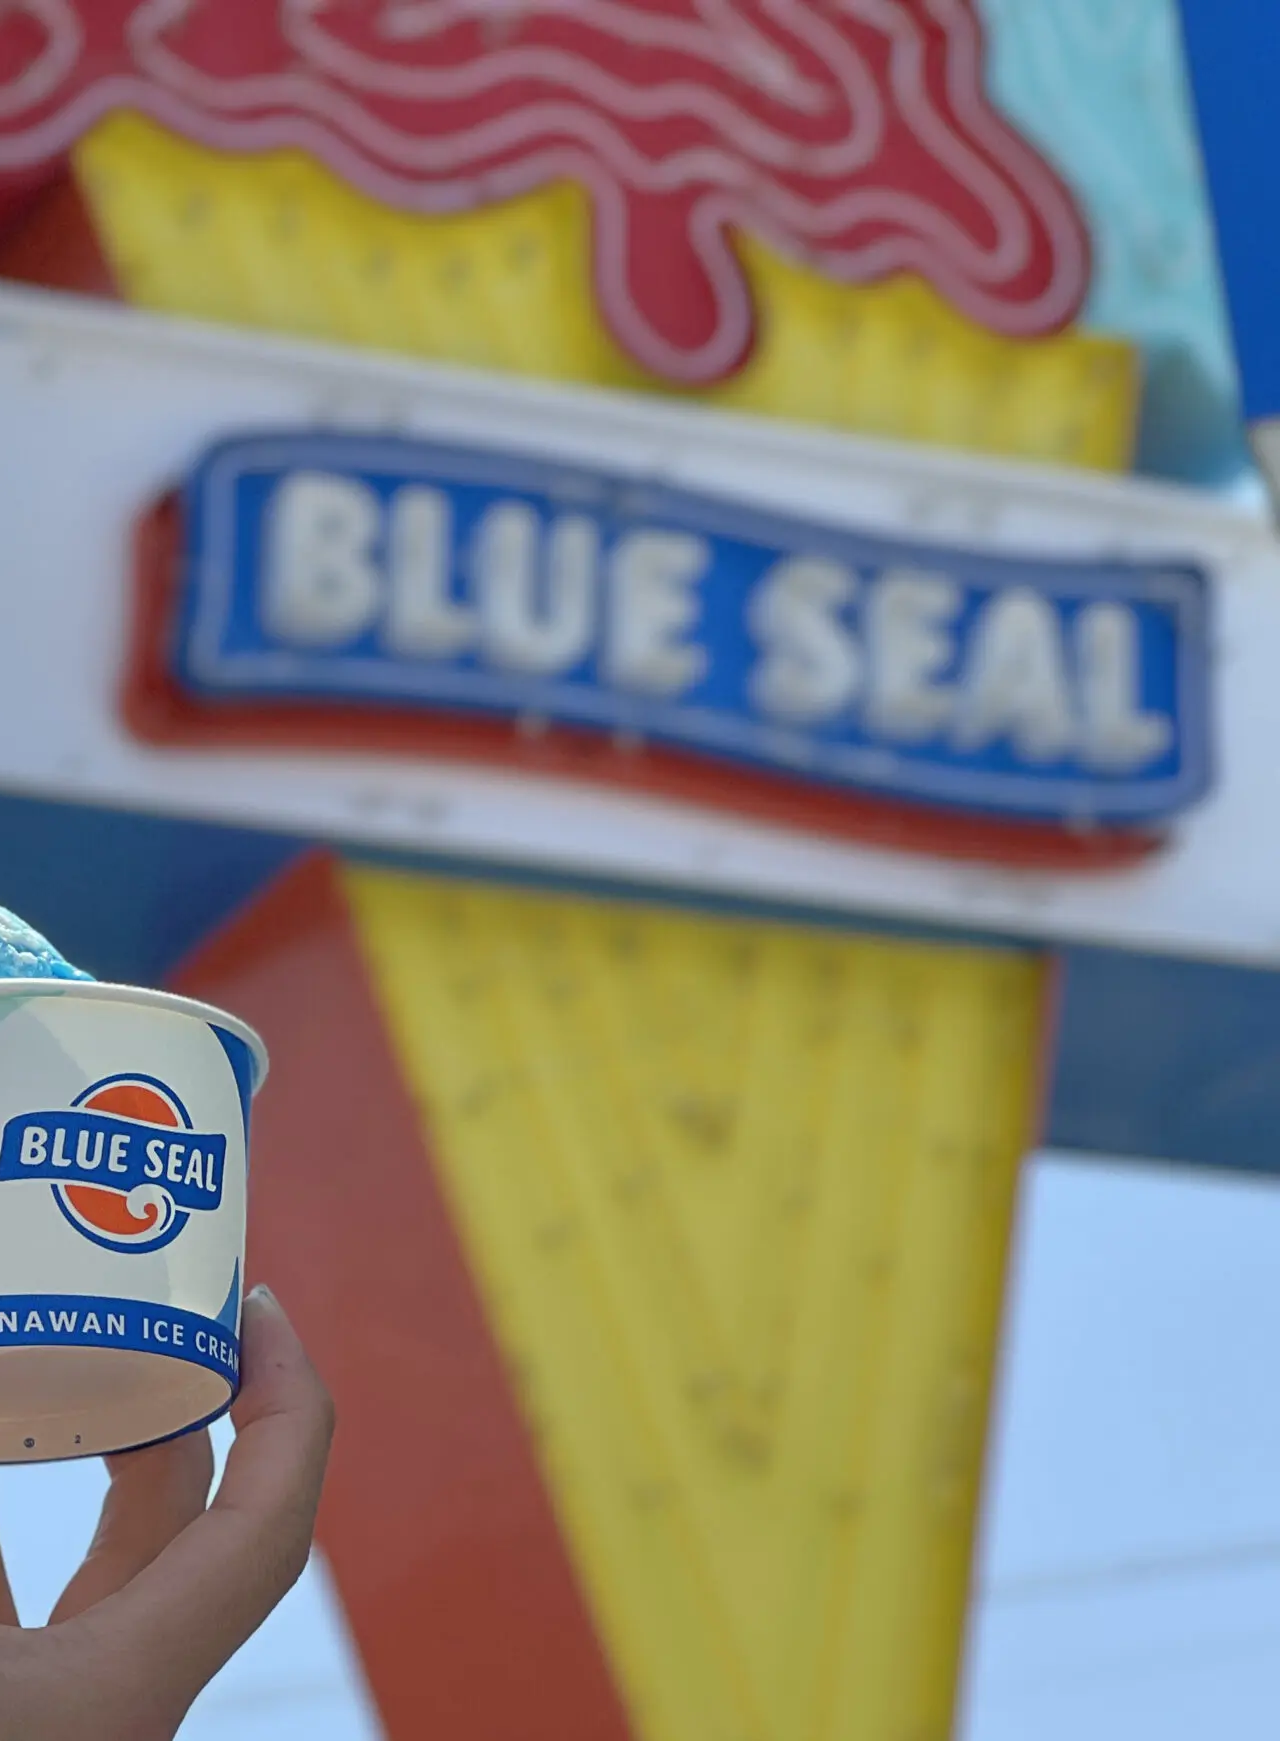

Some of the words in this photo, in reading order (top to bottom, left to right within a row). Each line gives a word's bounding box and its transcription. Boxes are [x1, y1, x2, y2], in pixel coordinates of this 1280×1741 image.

[260, 470, 710, 695] BLUE
[750, 556, 1172, 772] SEAL
[20, 1126, 130, 1172] BLUE
[144, 1139, 217, 1192] SEAL
[143, 1318, 184, 1346] ICE
